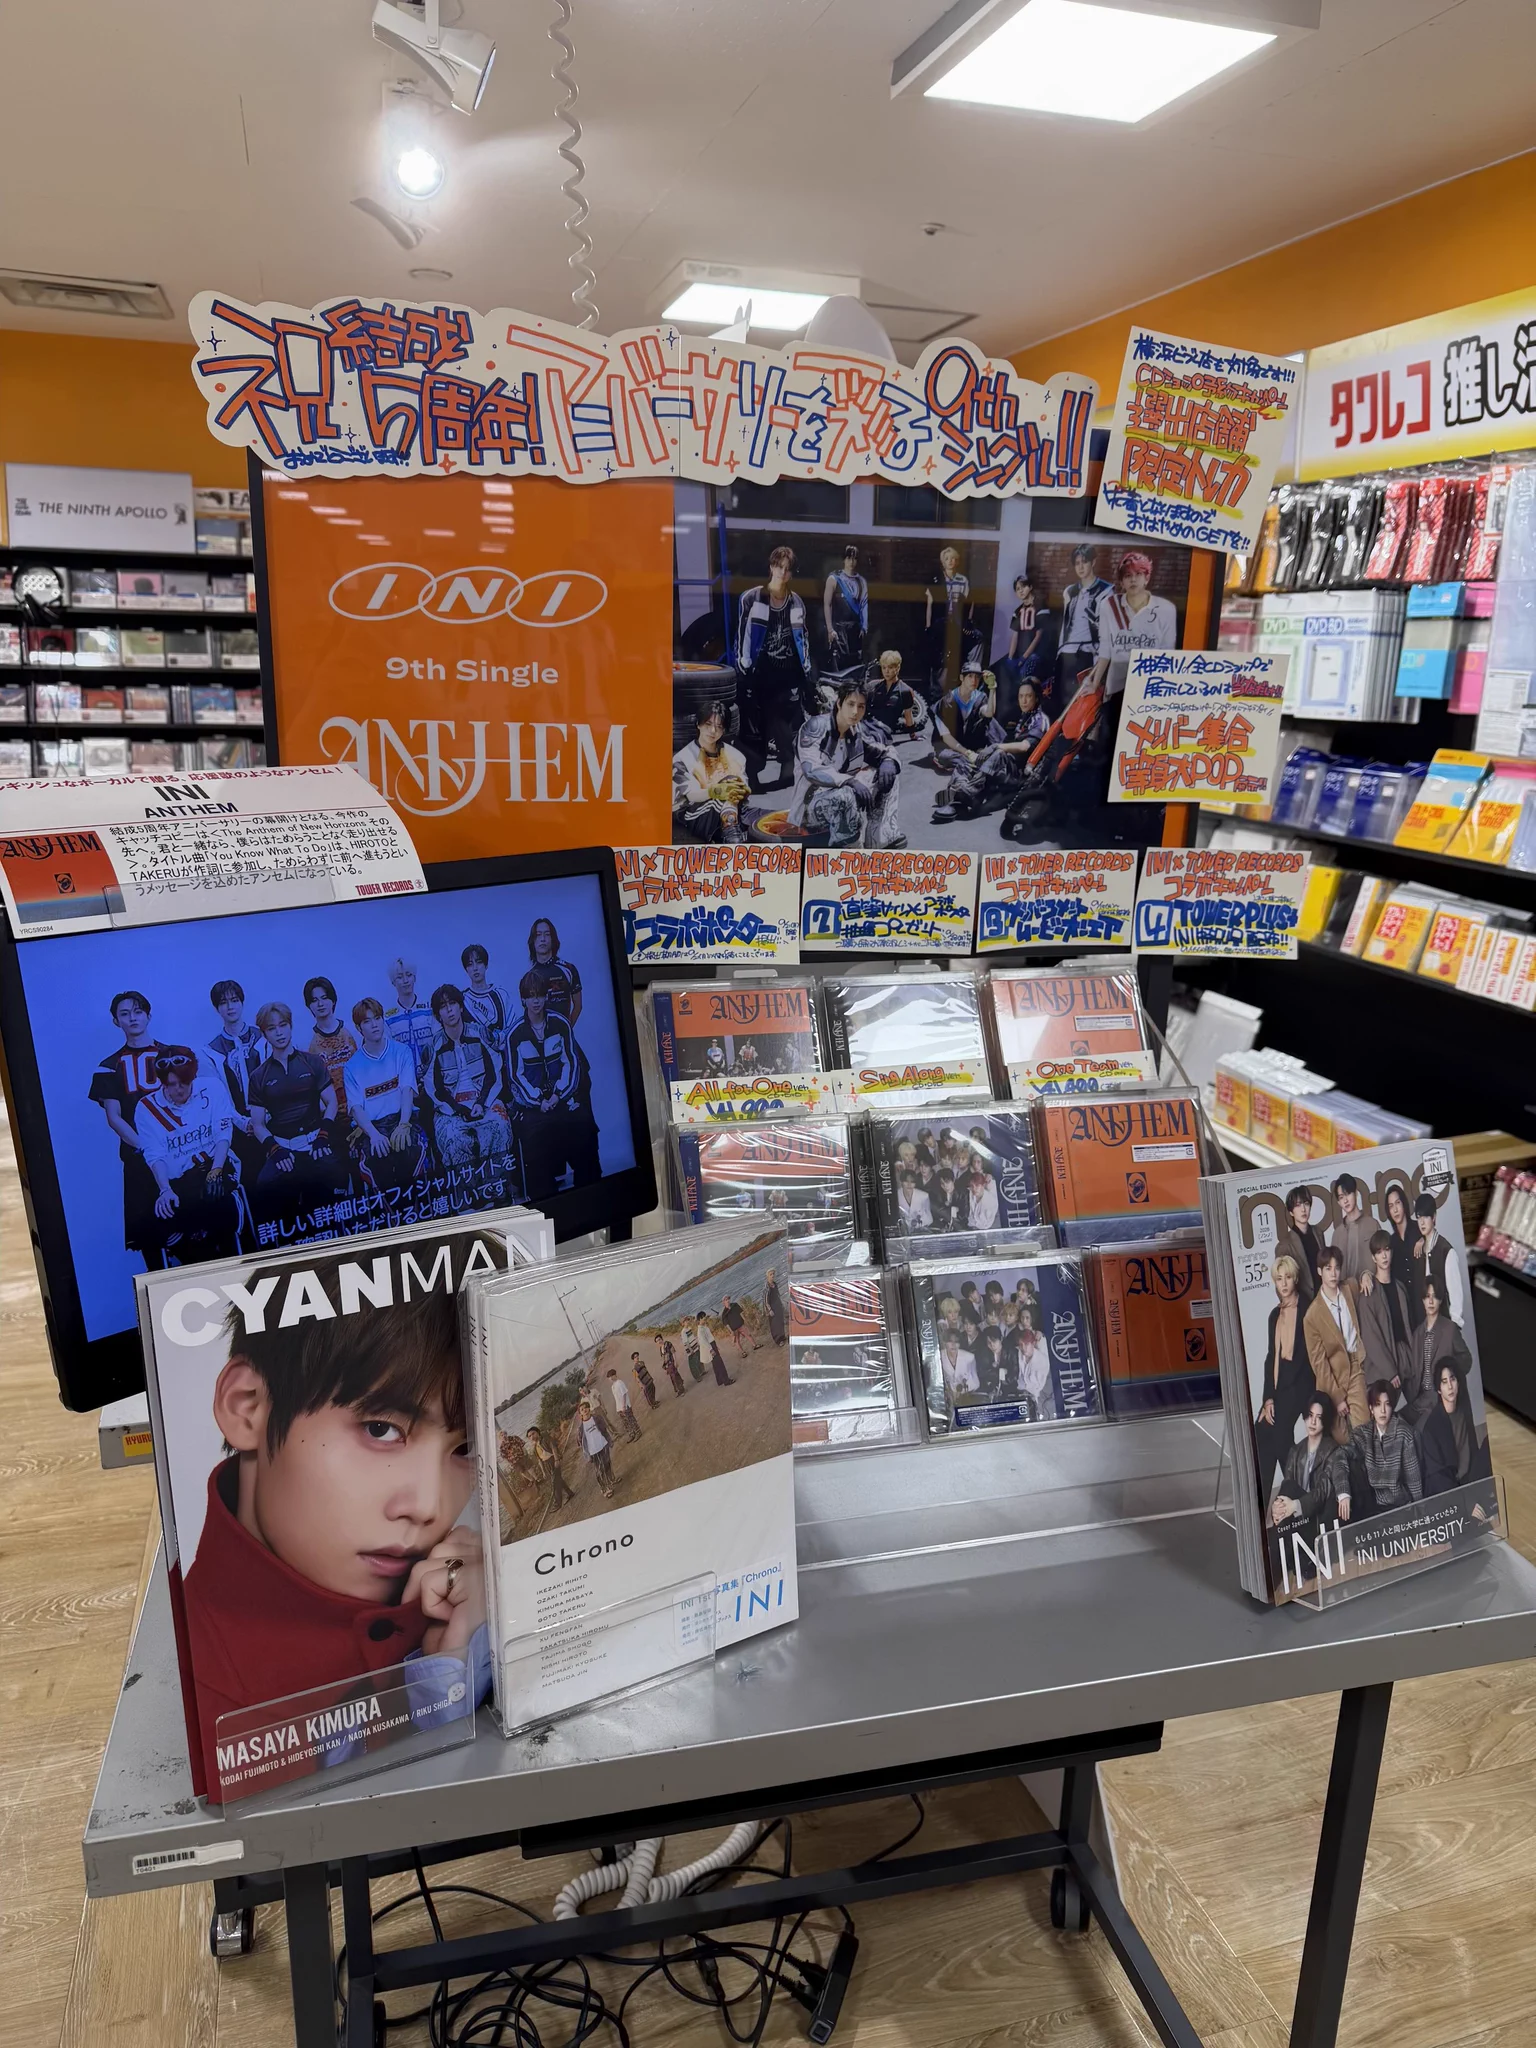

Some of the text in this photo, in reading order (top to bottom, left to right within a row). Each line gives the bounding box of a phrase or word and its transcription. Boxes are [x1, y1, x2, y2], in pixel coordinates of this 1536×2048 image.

[1330, 359, 1432, 449] タワレコ
[38, 501, 63, 514] THE
[67, 503, 111, 517] NINTH
[114, 506, 169, 520] APOLLO
[1019, 607, 1036, 631] 10
[386, 656, 559, 688] 9th Single
[319, 716, 628, 817] ANTHEM
[153, 784, 211, 802] INI
[145, 802, 240, 819] ANTHEM
[246, 823, 285, 836] Anthem
[288, 822, 299, 832] of
[300, 821, 322, 832] New
[324, 819, 367, 830] Horizons
[369, 817, 390, 828] その
[236, 849, 265, 860] Know
[267, 845, 293, 857] What
[297, 844, 310, 854] To
[656, 845, 802, 876] TOWER RECORDS
[807, 853, 829, 878] INI
[985, 851, 1135, 883] INI TOWER RECORDS
[1146, 850, 1305, 877] INI TOWER RECORDS
[355, 879, 415, 896] TOWER RECORDS
[709, 991, 804, 1025] ANTHEM
[1014, 977, 1131, 1018] ANTHEM
[120, 1051, 162, 1094] 10
[859, 1065, 945, 1090] Sing Along
[1036, 1061, 1075, 1080] One
[1074, 1058, 1120, 1074] Team
[200, 1087, 210, 1110] 5
[686, 1080, 722, 1106] All
[722, 1080, 753, 1101] for
[751, 1076, 793, 1095] One
[1068, 1101, 1191, 1148] ANTHEM
[257, 1152, 518, 1245] 詳しい詳細はオフィシャルサイトを
[1237, 1182, 1282, 1194] SPECIAL EDITION
[1257, 1211, 1270, 1226] 11
[1049, 1310, 1082, 1413] ANTHEM
[1277, 1517, 1310, 1534] Cover Special
[534, 1533, 635, 1576] Chrono
[1277, 1518, 1346, 1595] INI
[1357, 1517, 1464, 1566] INI UNIVERSITY
[735, 1579, 784, 1623] INI
[217, 1696, 383, 1772] MASAYA KIMURA
[220, 1772, 243, 1787] KODAI
[244, 1760, 279, 1779] FUJIMOTO
[288, 1744, 325, 1765] HIDEYOSHI
[326, 1737, 341, 1751] KAN
[348, 1727, 372, 1743] NAOYA
[372, 1713, 410, 1735] KUSAKAWA
[416, 1706, 433, 1719] RIKU
[433, 1698, 453, 1714] SHIGA
